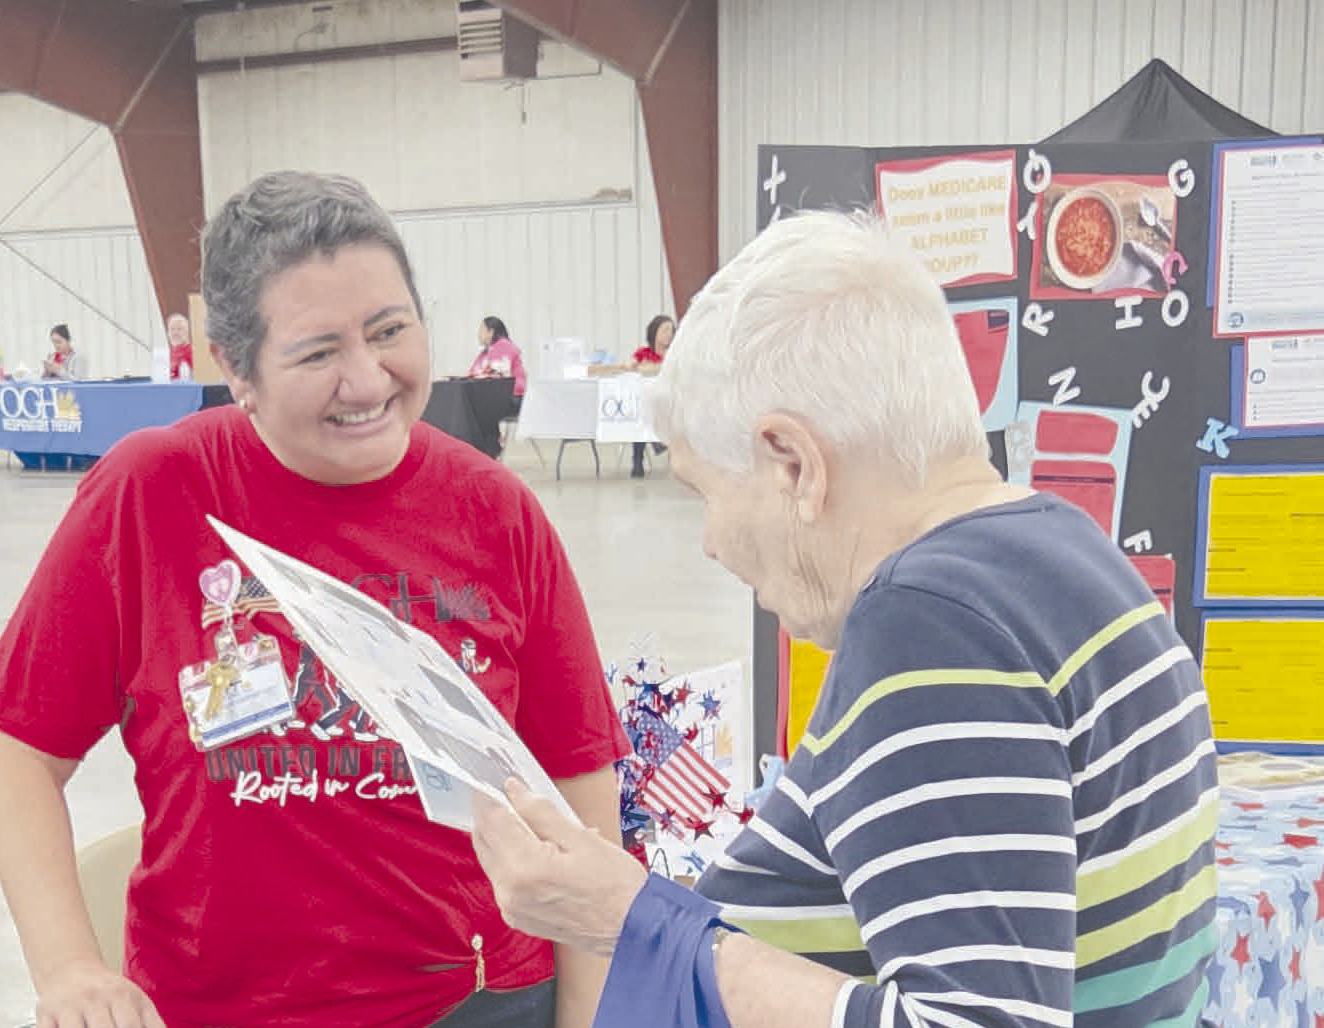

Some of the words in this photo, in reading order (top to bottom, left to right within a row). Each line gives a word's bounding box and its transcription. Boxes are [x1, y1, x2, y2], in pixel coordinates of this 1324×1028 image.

[0, 386, 59, 418] OGH
[205, 745, 317, 781] UNITED
[328, 745, 361, 778] IN
[230, 767, 319, 807] Rooted
